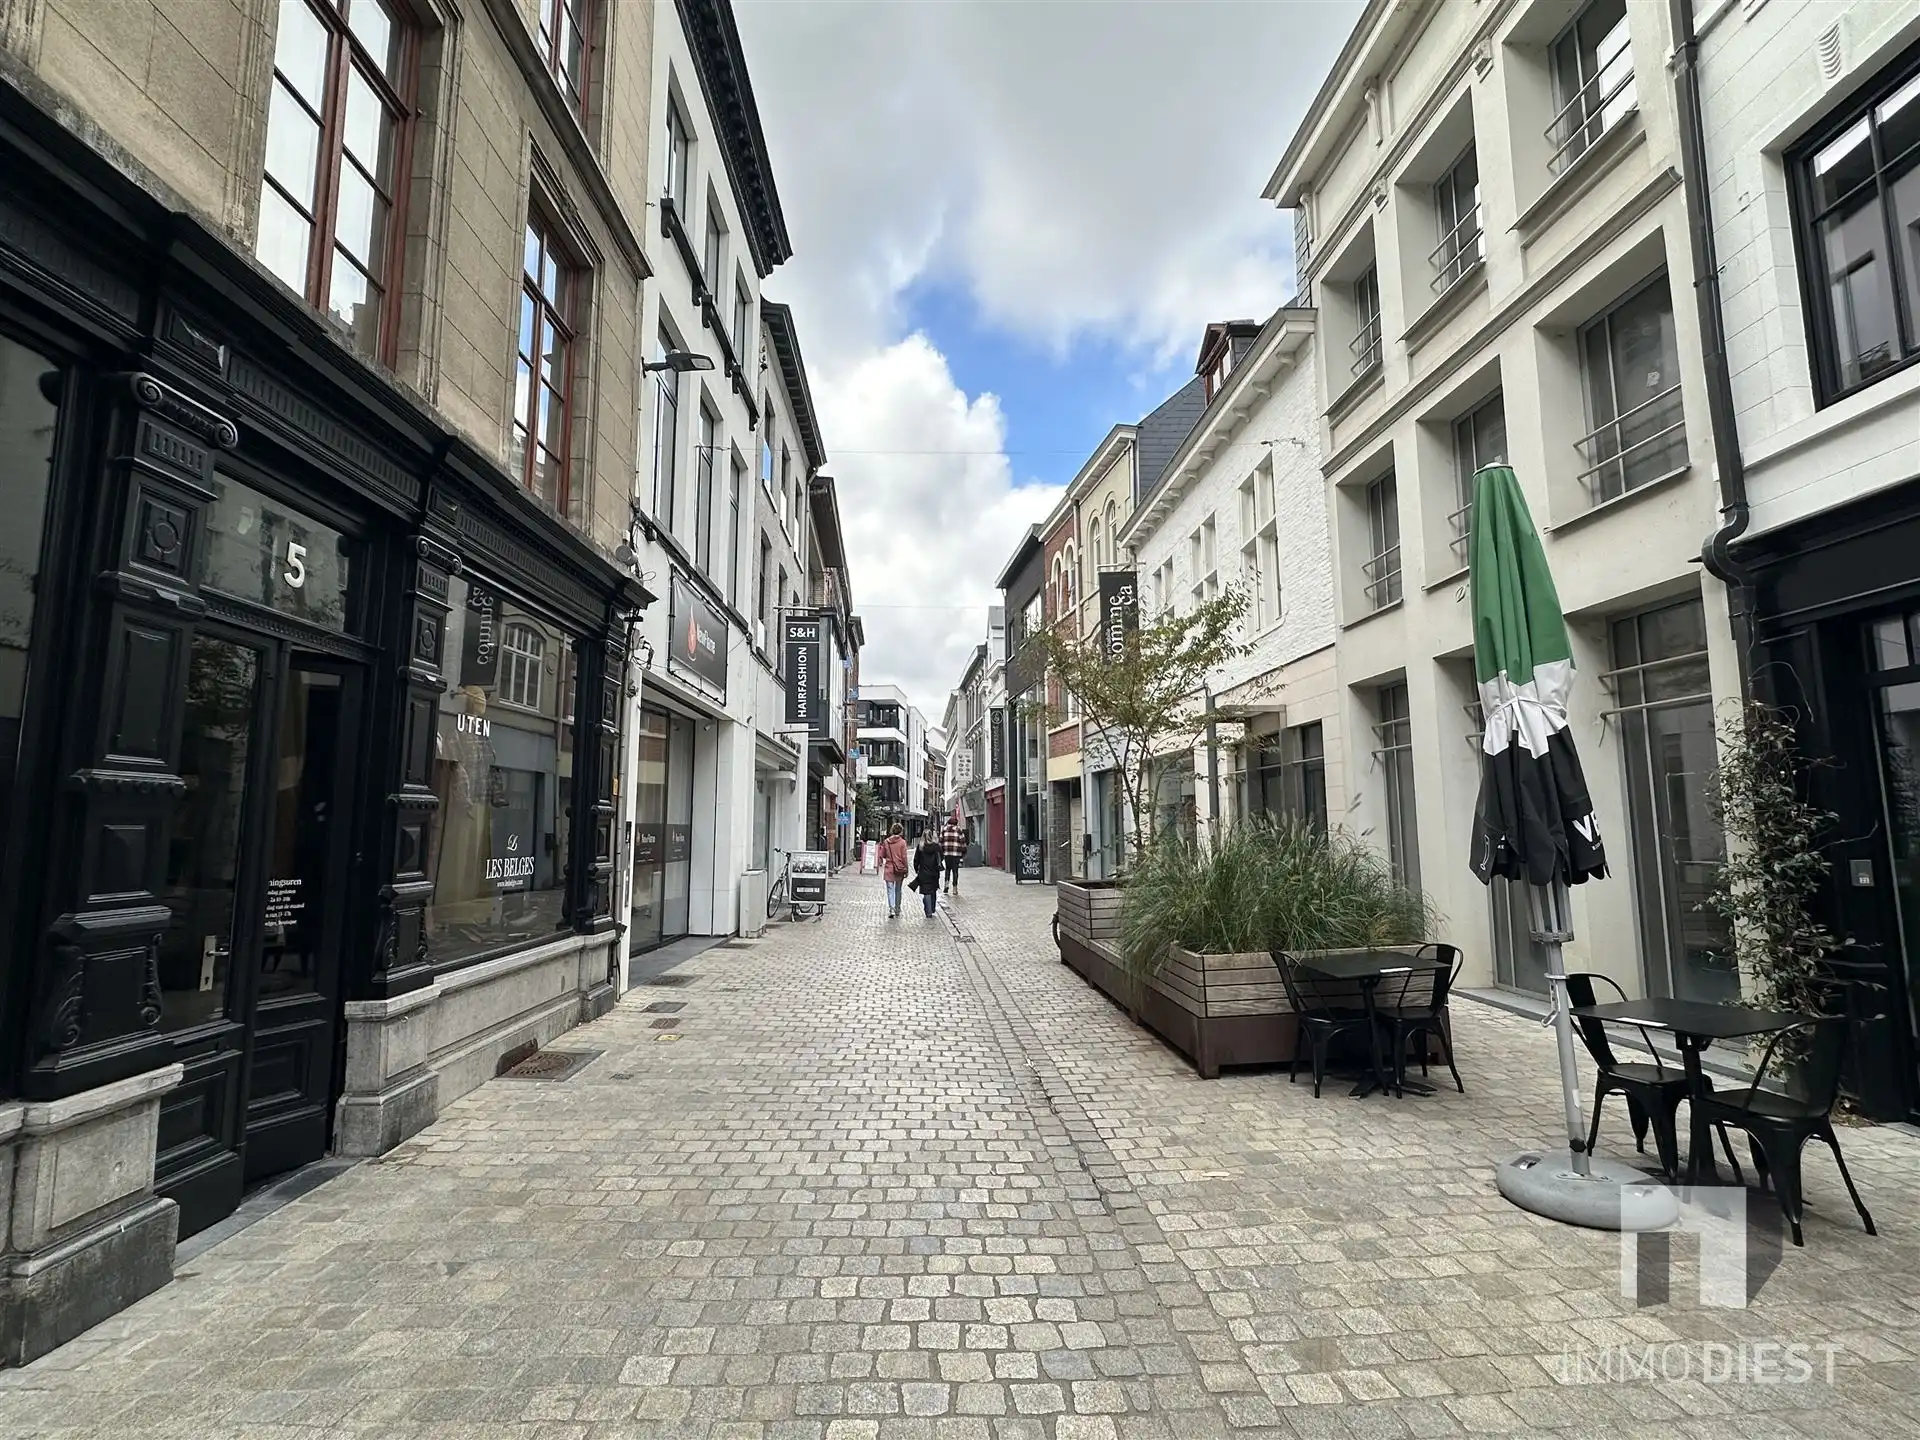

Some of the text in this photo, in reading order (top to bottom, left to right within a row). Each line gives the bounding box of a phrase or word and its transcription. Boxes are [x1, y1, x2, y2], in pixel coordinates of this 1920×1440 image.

[283, 541, 307, 589] 5
[1120, 584, 1137, 605] ça
[789, 627, 816, 638] S&H
[797, 647, 808, 718] HAIRFASHION
[457, 713, 491, 737] UTEN
[485, 856, 535, 880] LES BELGES
